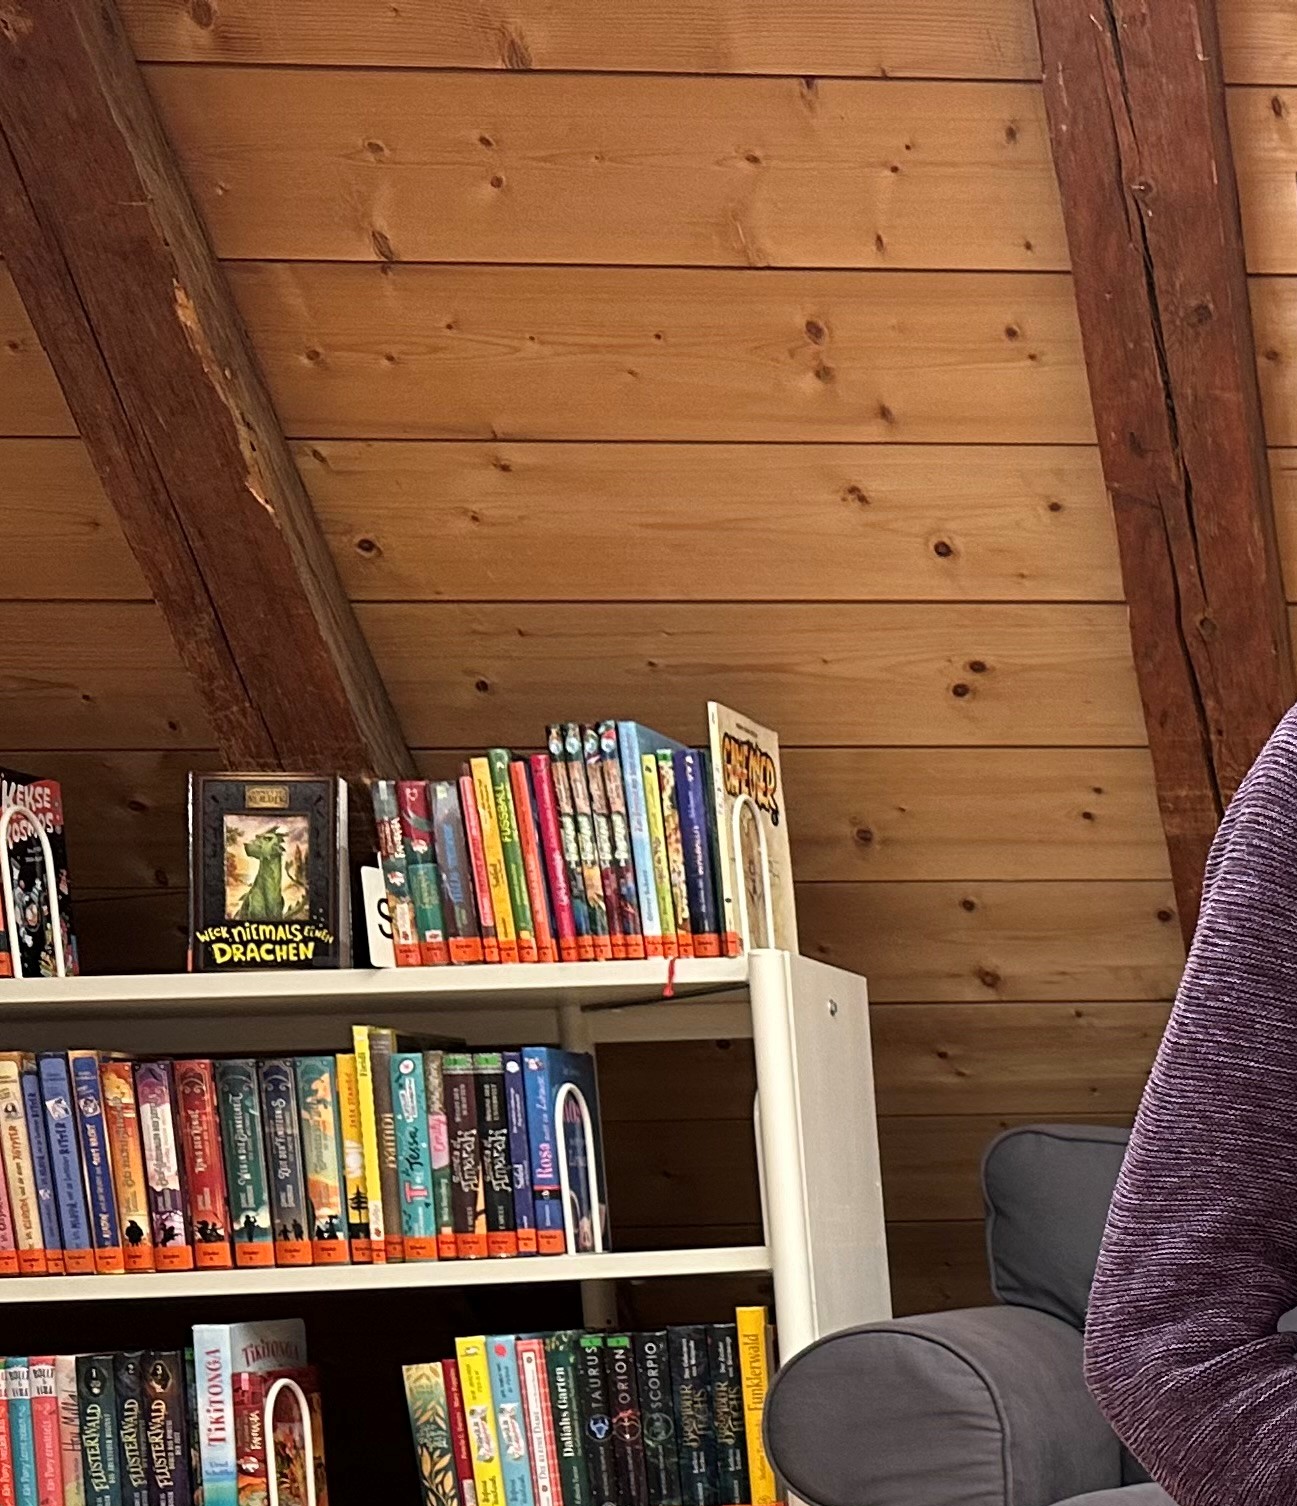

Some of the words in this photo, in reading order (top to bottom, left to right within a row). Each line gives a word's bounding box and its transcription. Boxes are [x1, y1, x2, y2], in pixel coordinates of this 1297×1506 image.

[1, 780, 52, 812] KEKSE
[494, 783, 512, 842] FUSSBALL
[195, 926, 230, 943] WECK
[377, 898, 393, 939] S
[211, 941, 315, 964] DRACHEN
[408, 1125, 425, 1174] Tessa
[536, 1142, 553, 1179] Rosa
[585, 1345, 604, 1409] TAURUS
[614, 1348, 631, 1404] ORION
[644, 1342, 662, 1409] SCORPIO
[743, 1333, 764, 1412] Funklerwald
[82, 1403, 110, 1493] FLÜSTERWALD
[121, 1398, 147, 1488] FLÜSTERWALD
[148, 1399, 173, 1490] FLÜSTERWALD
